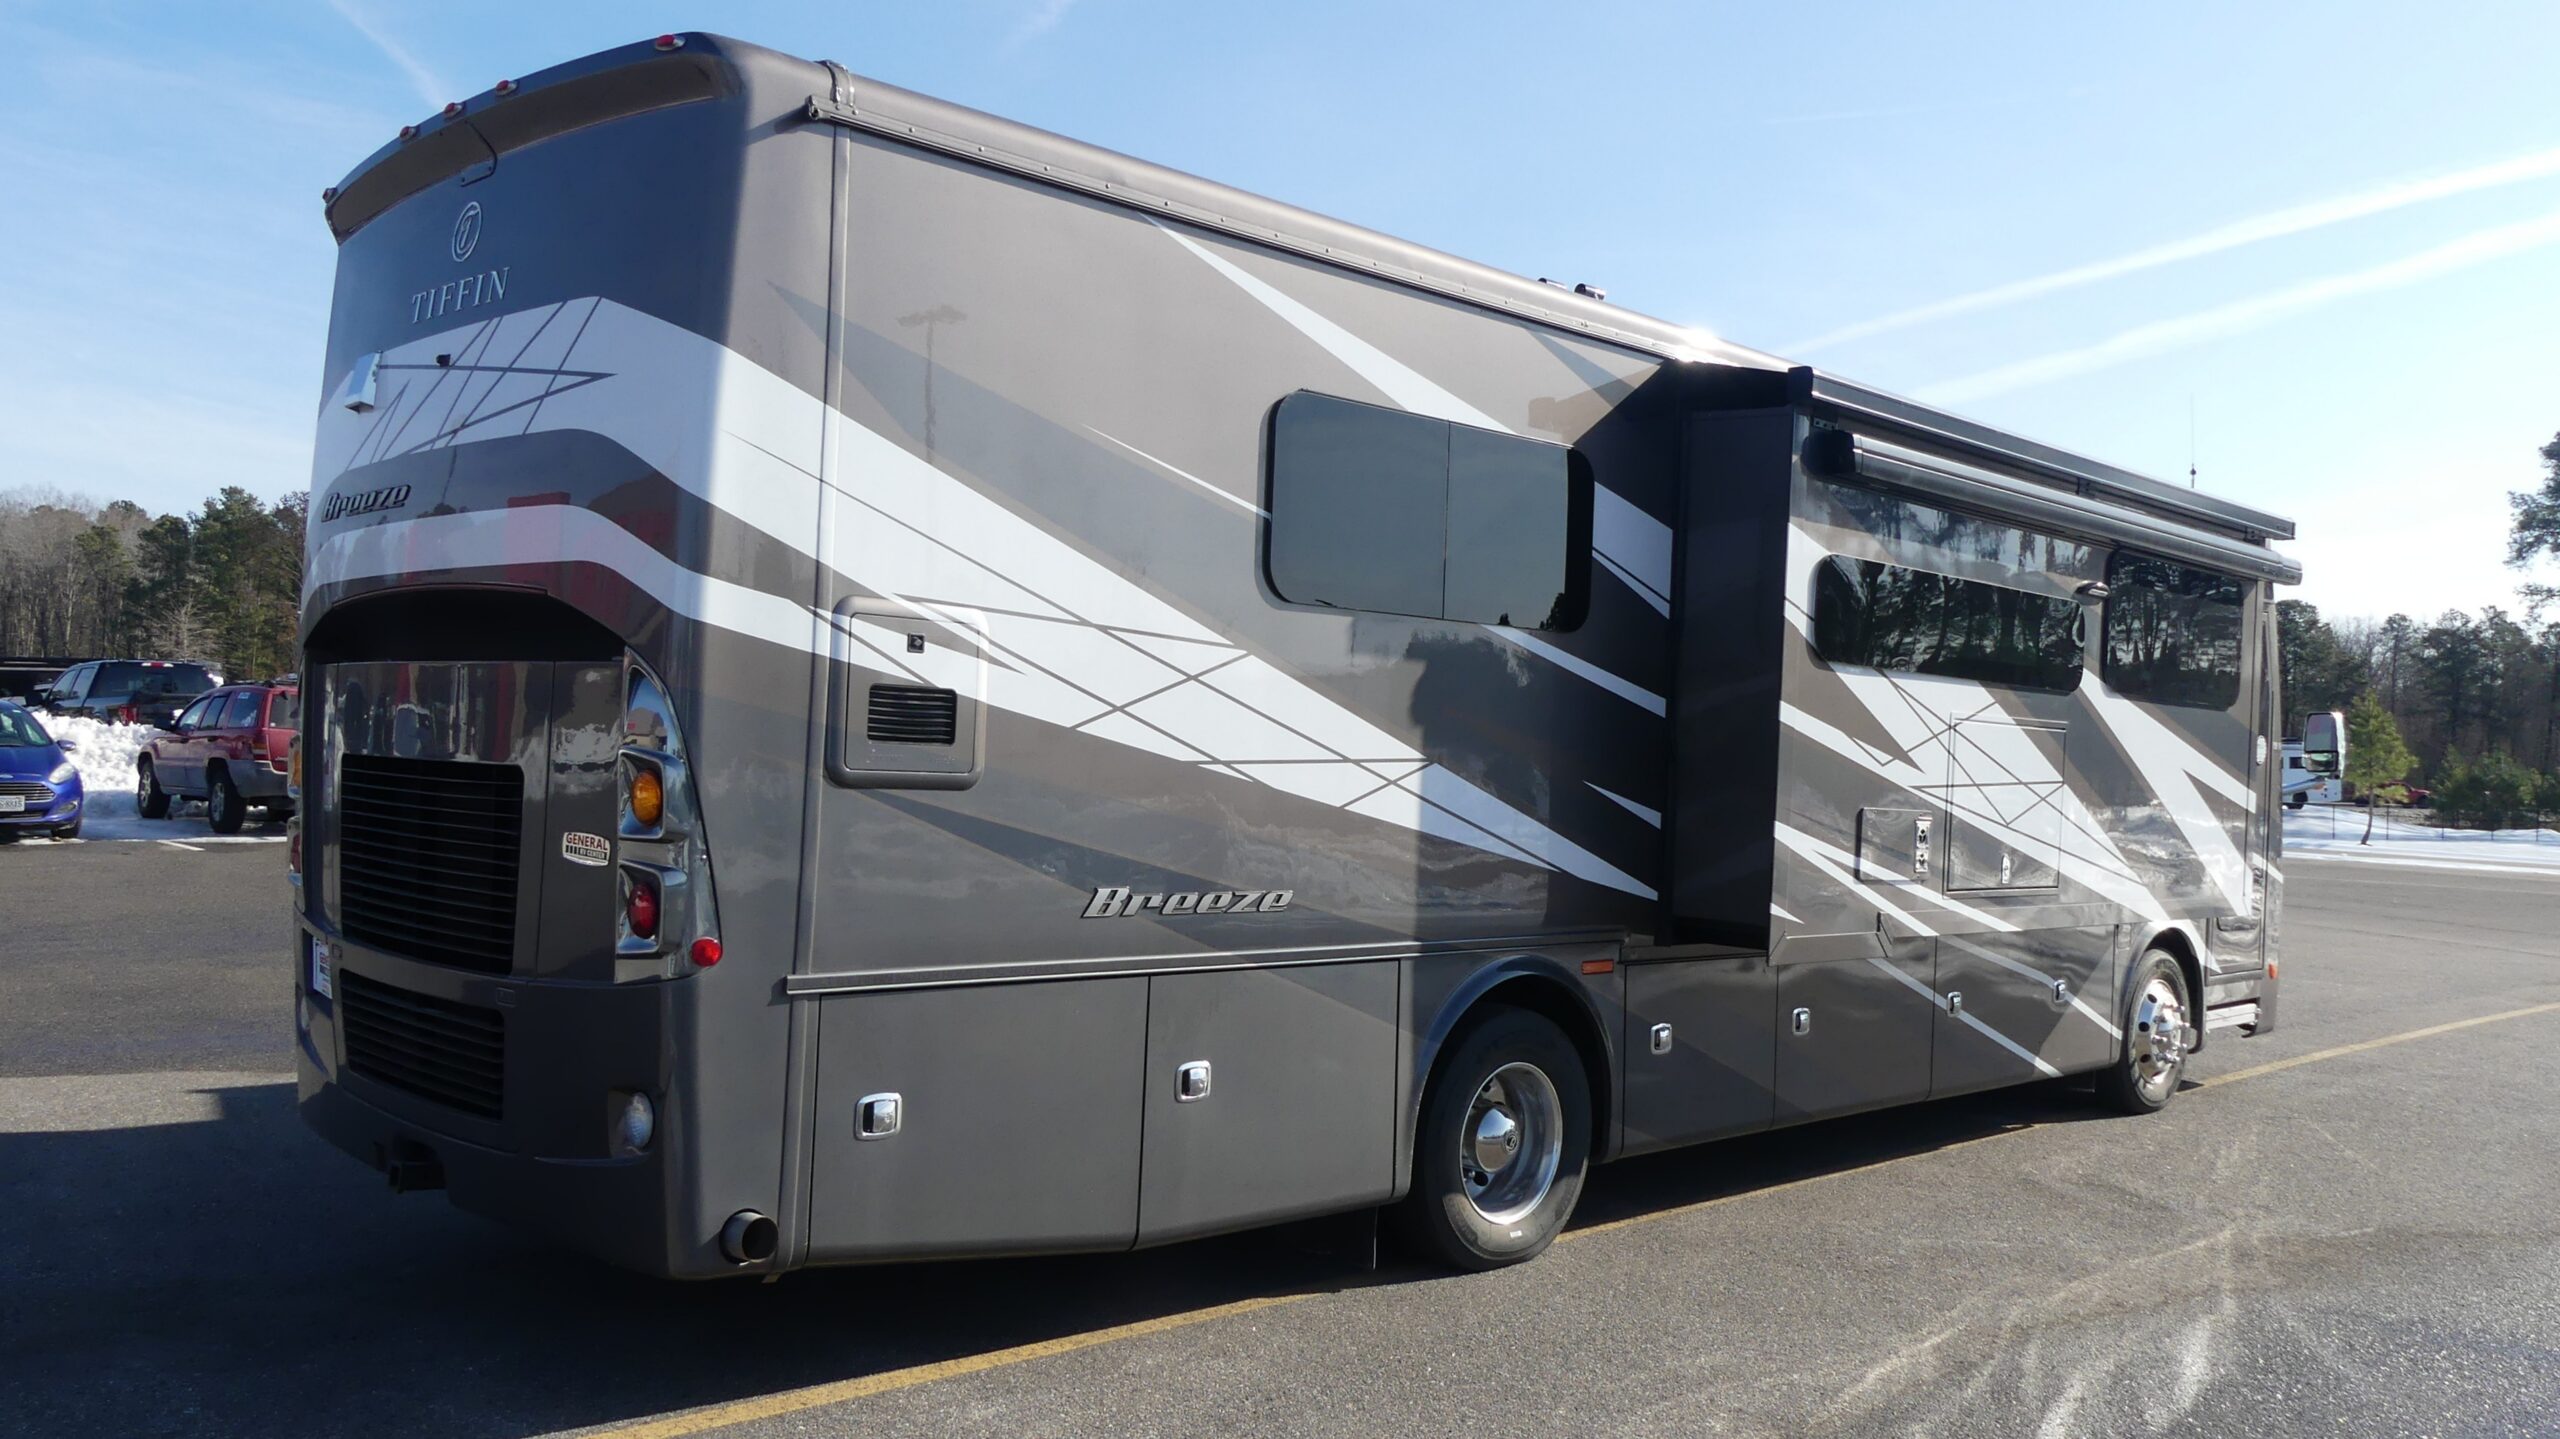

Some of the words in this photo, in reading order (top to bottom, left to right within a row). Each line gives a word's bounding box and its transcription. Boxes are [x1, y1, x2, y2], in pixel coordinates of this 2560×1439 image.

[412, 266, 510, 323] TIFFIN
[321, 484, 411, 523] Breeze
[566, 833, 608, 851] GENERAL
[1080, 886, 1294, 919] Breeze
